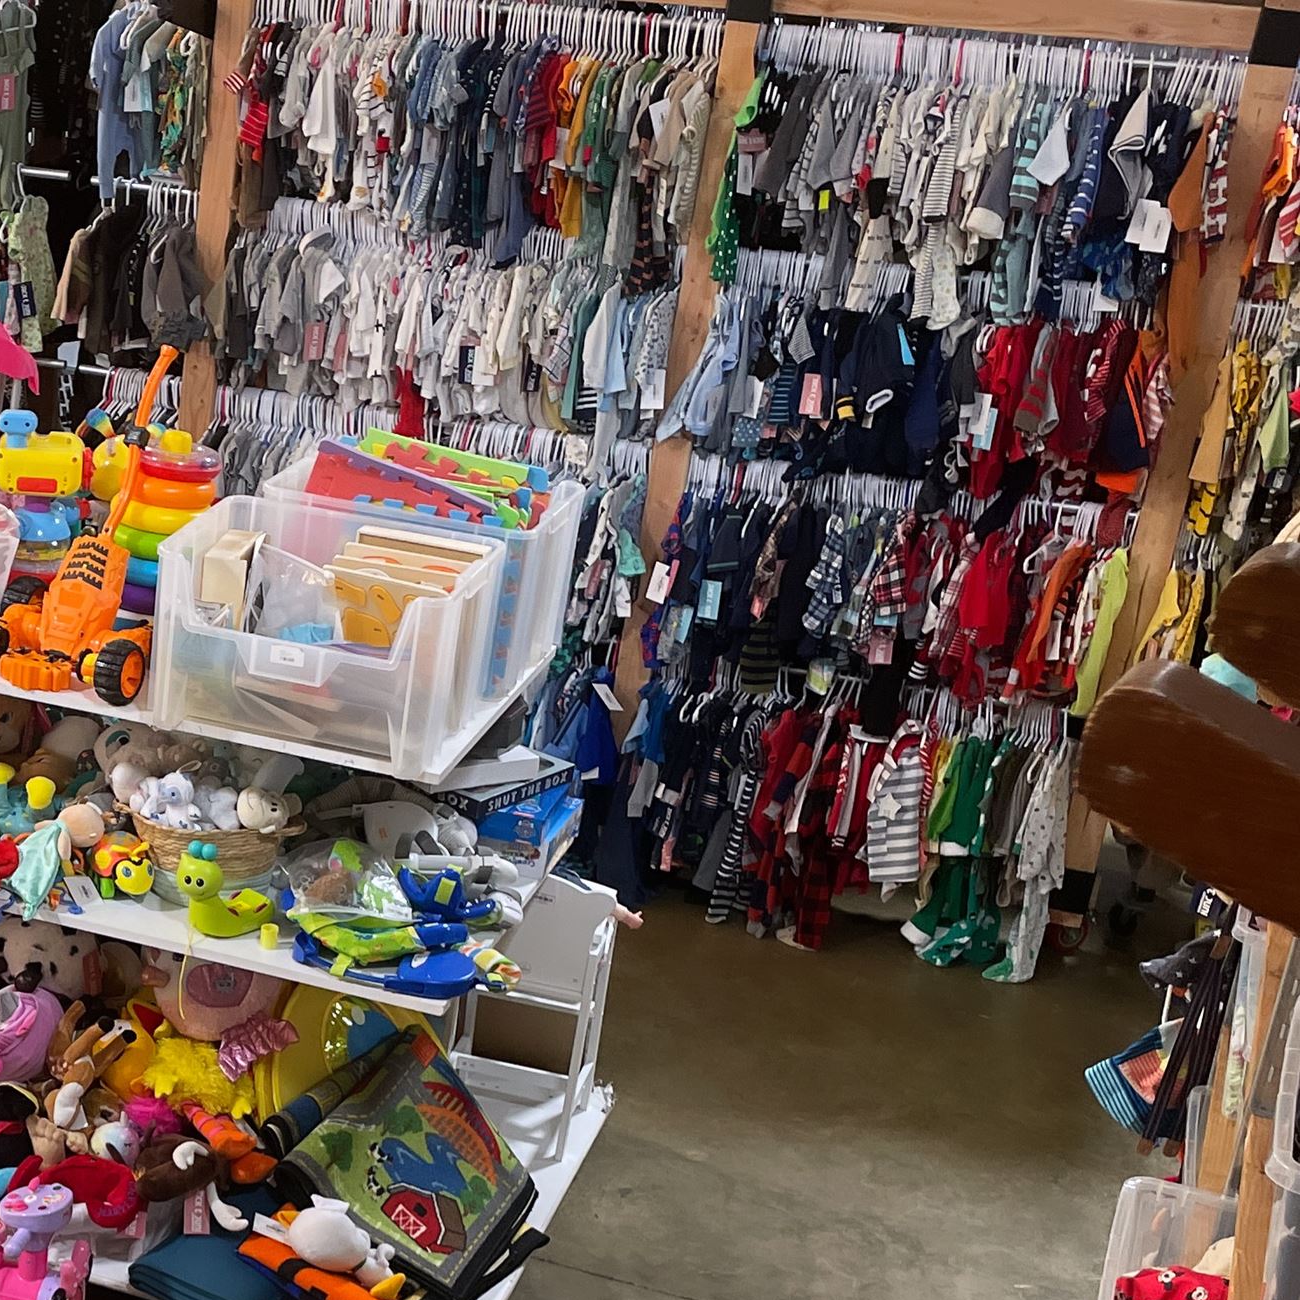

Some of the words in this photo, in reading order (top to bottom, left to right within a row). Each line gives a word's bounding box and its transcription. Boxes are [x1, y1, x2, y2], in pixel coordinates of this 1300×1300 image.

[487, 791, 518, 812] SHUT
[521, 783, 542, 797] THE
[545, 770, 569, 791] BOX
